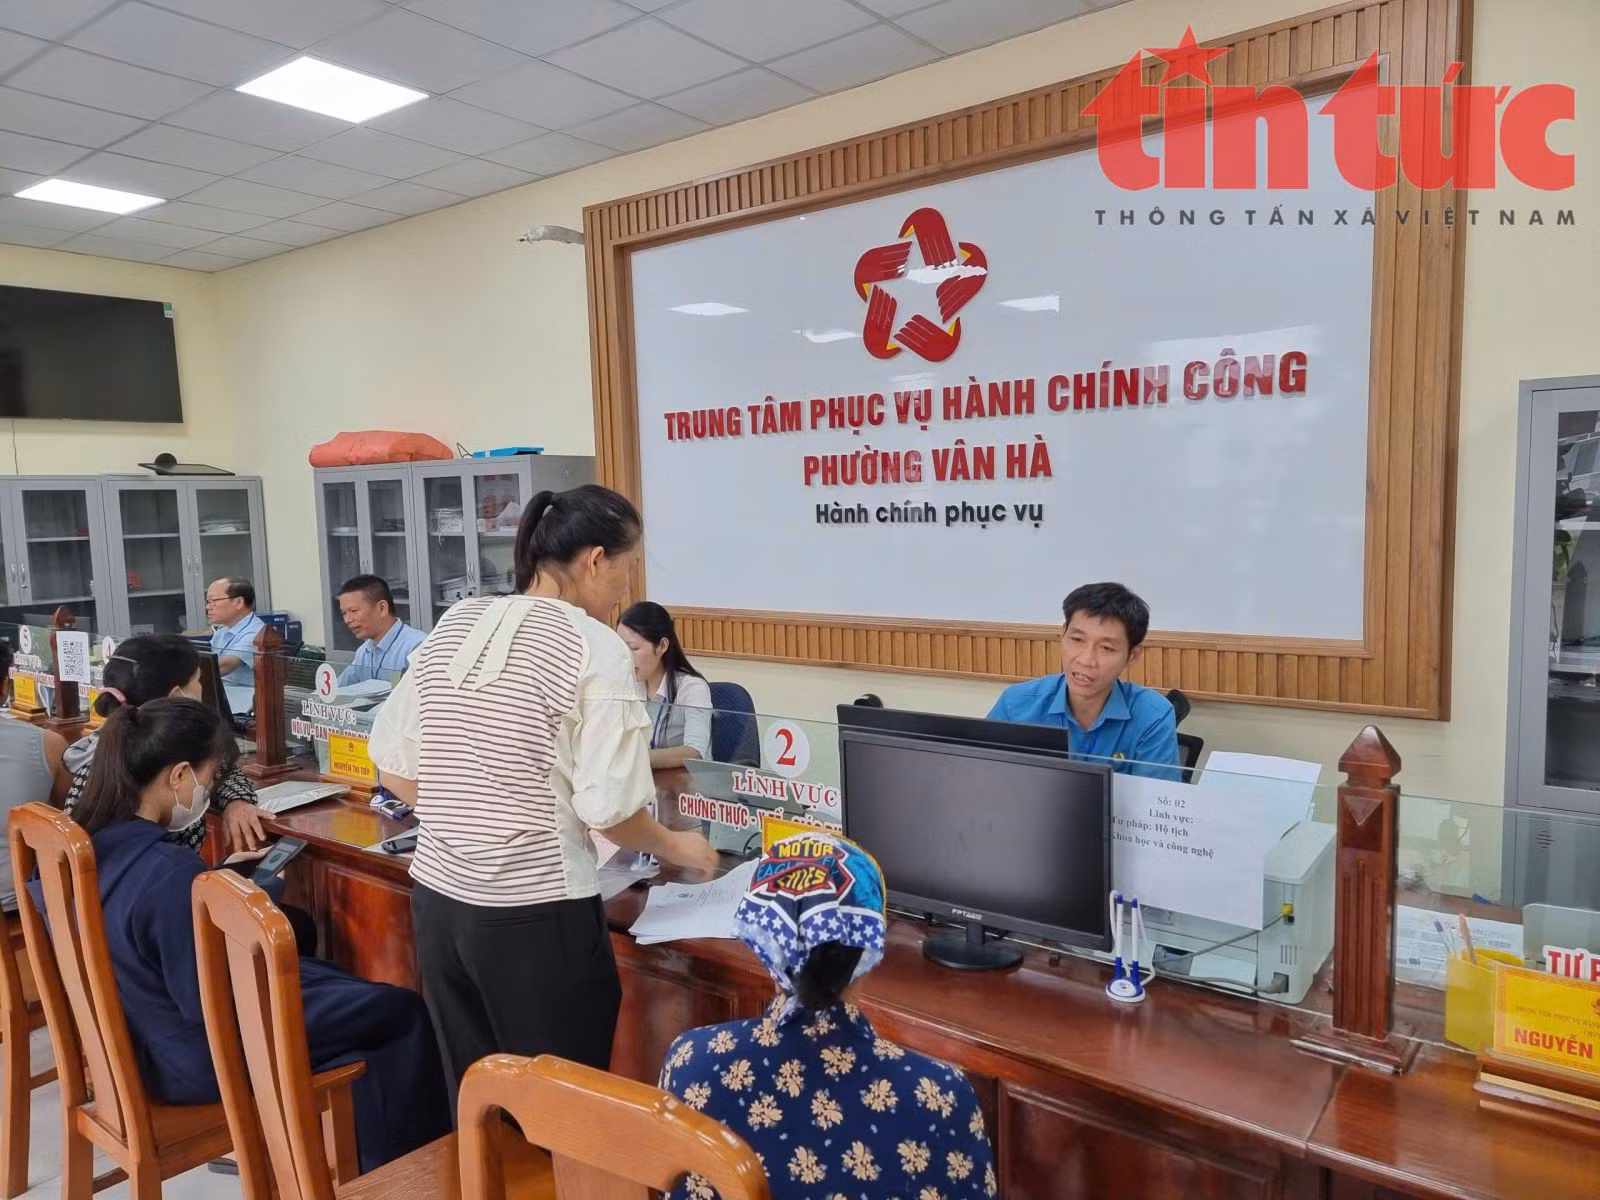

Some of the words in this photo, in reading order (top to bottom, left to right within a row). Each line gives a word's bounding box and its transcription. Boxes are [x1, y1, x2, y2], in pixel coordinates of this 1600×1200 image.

[664, 406, 742, 441] TRUNG
[747, 395, 802, 435] TÂM
[809, 393, 885, 435] PHỤC
[893, 388, 933, 432] VỤ
[942, 375, 1036, 422] HÀNH
[1047, 360, 1170, 412] CHÍNH
[1183, 347, 1308, 401] CÔNG
[803, 444, 922, 487] PHƯỜNG
[931, 438, 995, 482] VÂN
[1006, 434, 1053, 479] HÀ
[815, 500, 869, 524] Hành
[875, 499, 937, 523] chính
[945, 501, 1007, 529] phục
[1013, 502, 1044, 528] vụ
[321, 670, 331, 696] 3
[774, 728, 797, 766] 2
[734, 770, 786, 798] LĨNH
[790, 782, 838, 809] VỰC
[1174, 799, 1186, 809] 02
[680, 793, 717, 821] CHỨNG
[719, 804, 749, 829] THỰC
[1149, 808, 1171, 821] Lĩnh
[778, 839, 834, 857] MOTOR
[1547, 950, 1585, 979] TƯ
[1514, 1027, 1594, 1059] NGUYỄN
